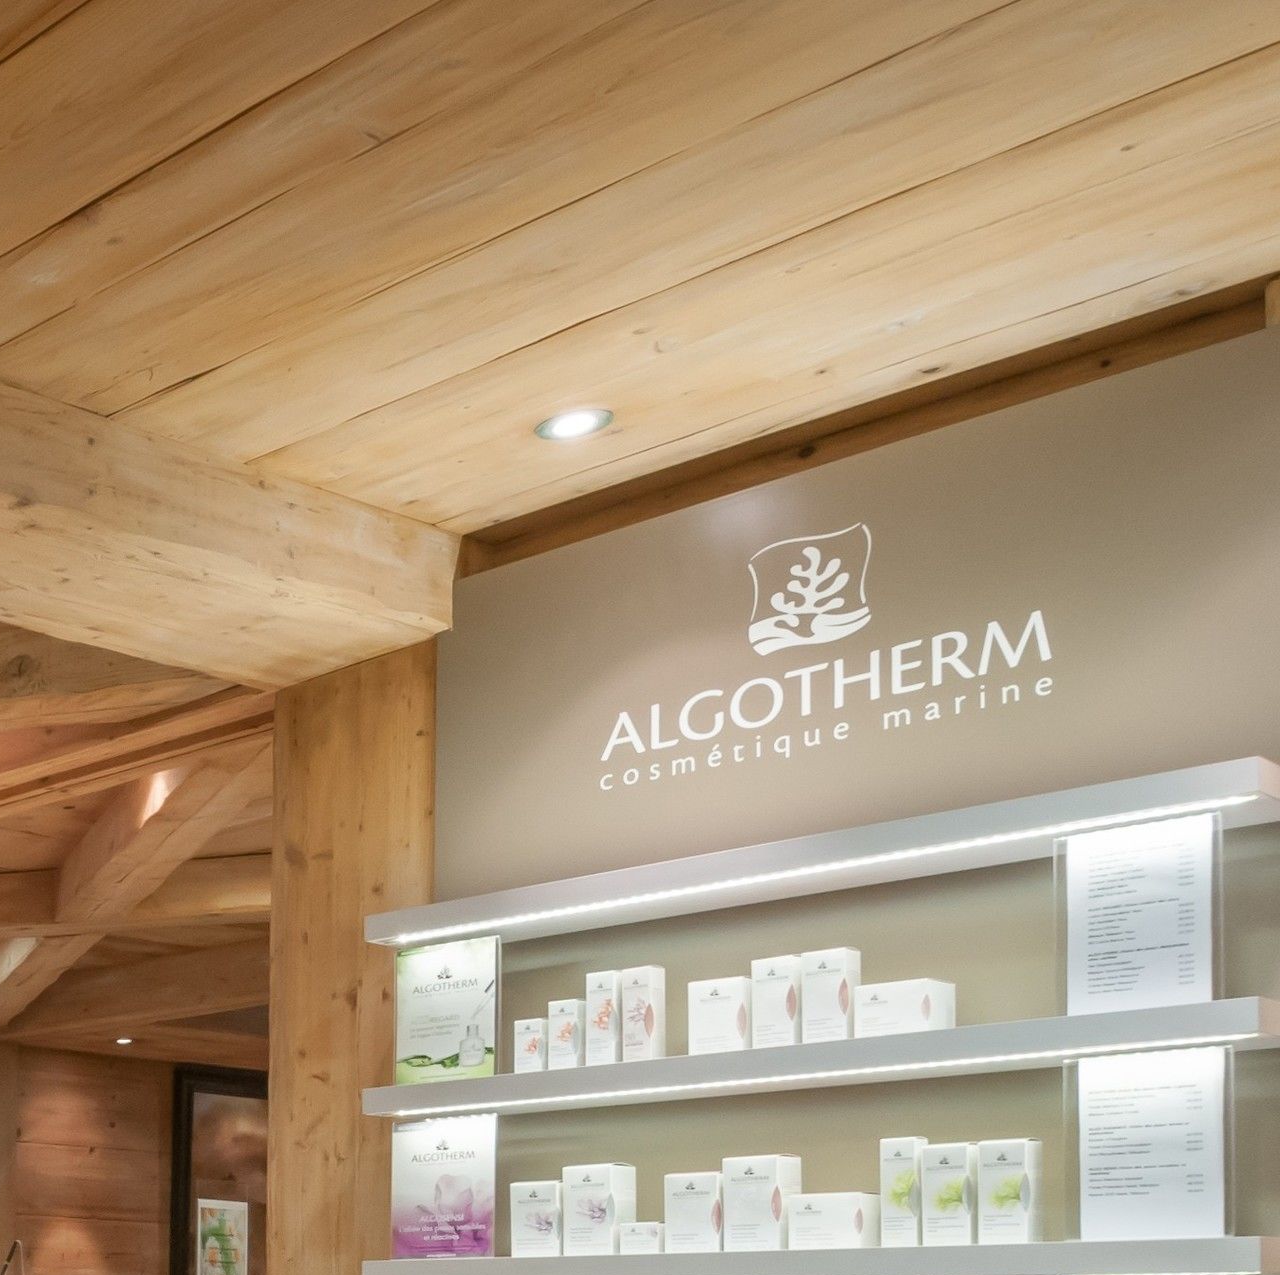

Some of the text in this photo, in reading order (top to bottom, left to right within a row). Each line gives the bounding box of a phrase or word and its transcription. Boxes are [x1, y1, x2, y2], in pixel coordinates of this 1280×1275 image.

[600, 610, 1052, 761] ALGOTHERM
[599, 676, 1054, 791] cosmétique marine
[412, 979, 478, 995] ALGOTHERM
[411, 1150, 476, 1163] ALGOTHERM
